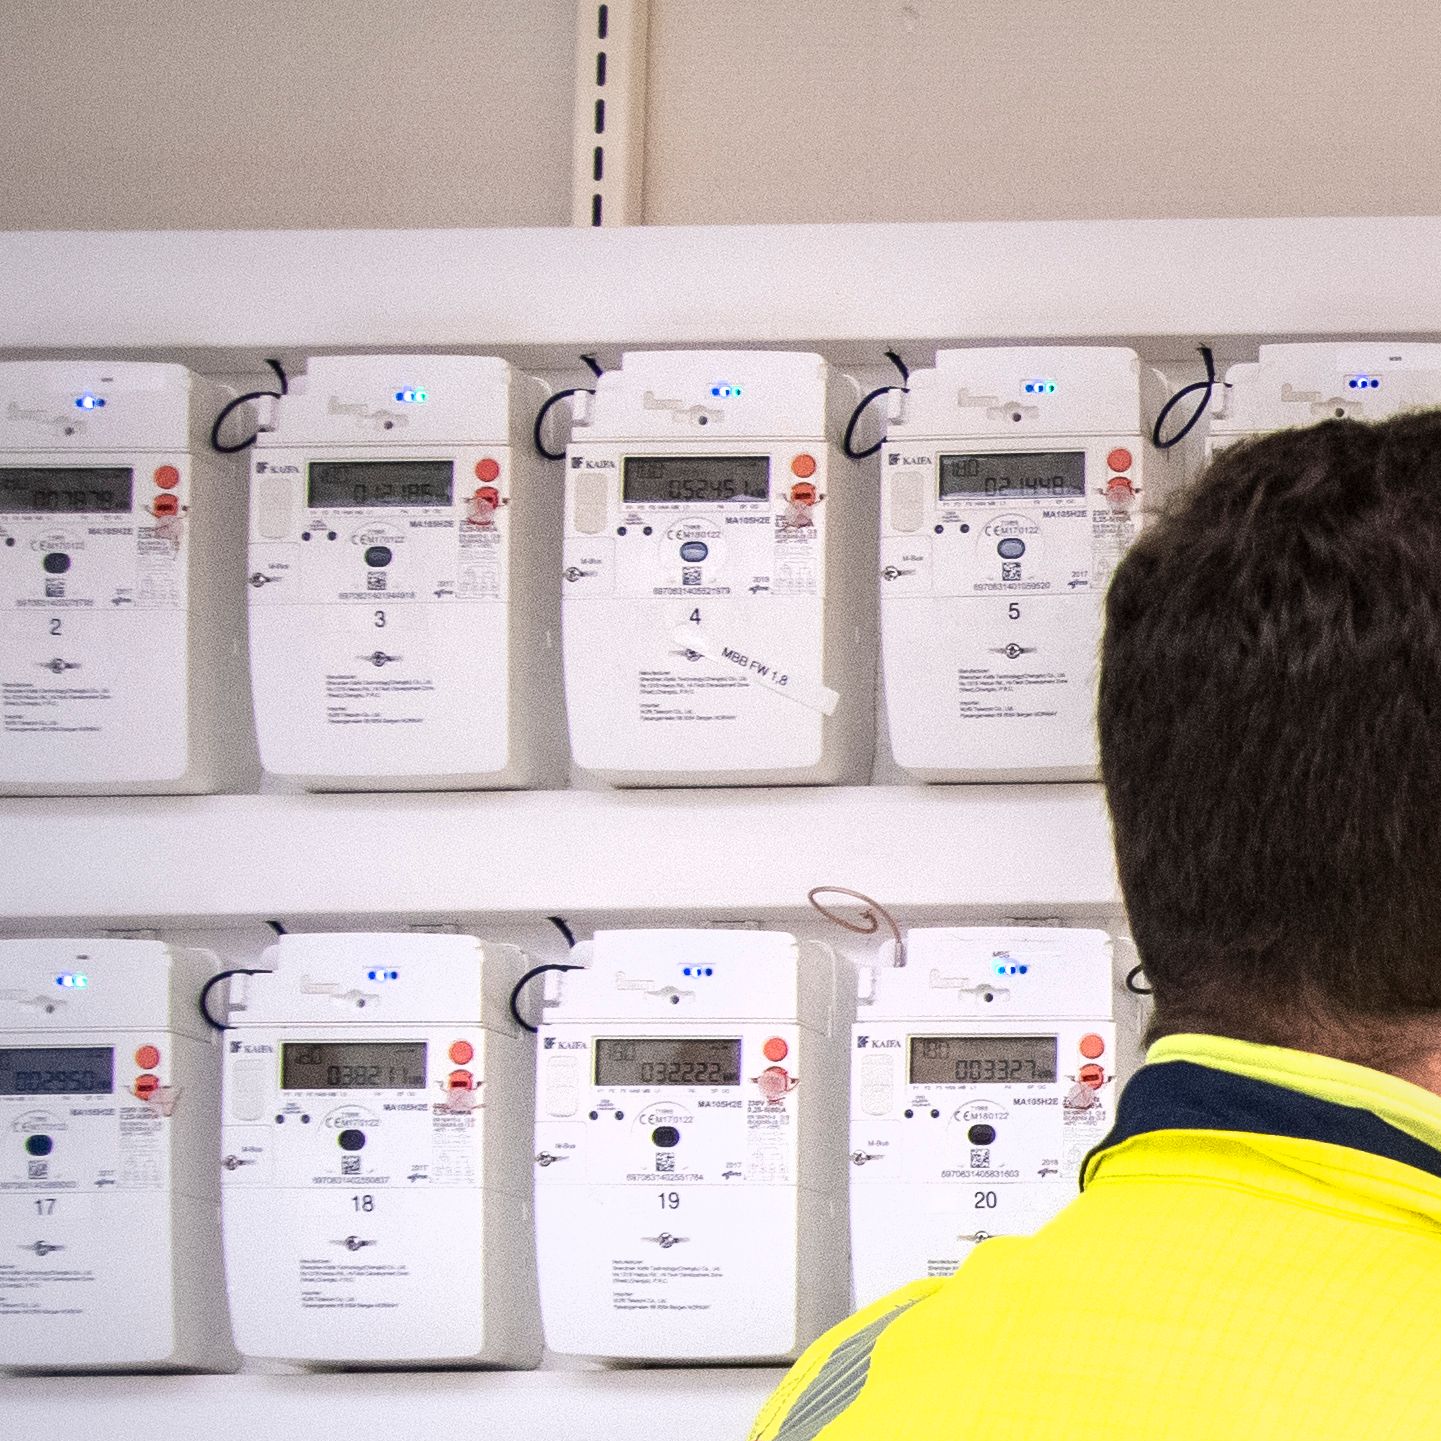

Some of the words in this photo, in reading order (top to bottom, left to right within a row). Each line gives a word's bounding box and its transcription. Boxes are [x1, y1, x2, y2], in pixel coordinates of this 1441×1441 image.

[903, 457, 932, 465] KAIFA
[375, 610, 386, 628] 3
[690, 608, 701, 624] 4
[1009, 602, 1020, 620] 5
[50, 618, 61, 636] 2
[721, 647, 749, 667] MBB
[750, 660, 769, 676] FW
[772, 671, 787, 686] 1.8
[872, 1040, 901, 1048] KAIFA
[956, 1060, 1035, 1080] 003327
[35, 1198, 56, 1215] 17
[352, 1195, 374, 1212] 18
[659, 1192, 680, 1209] 19
[975, 1191, 997, 1209] 20
